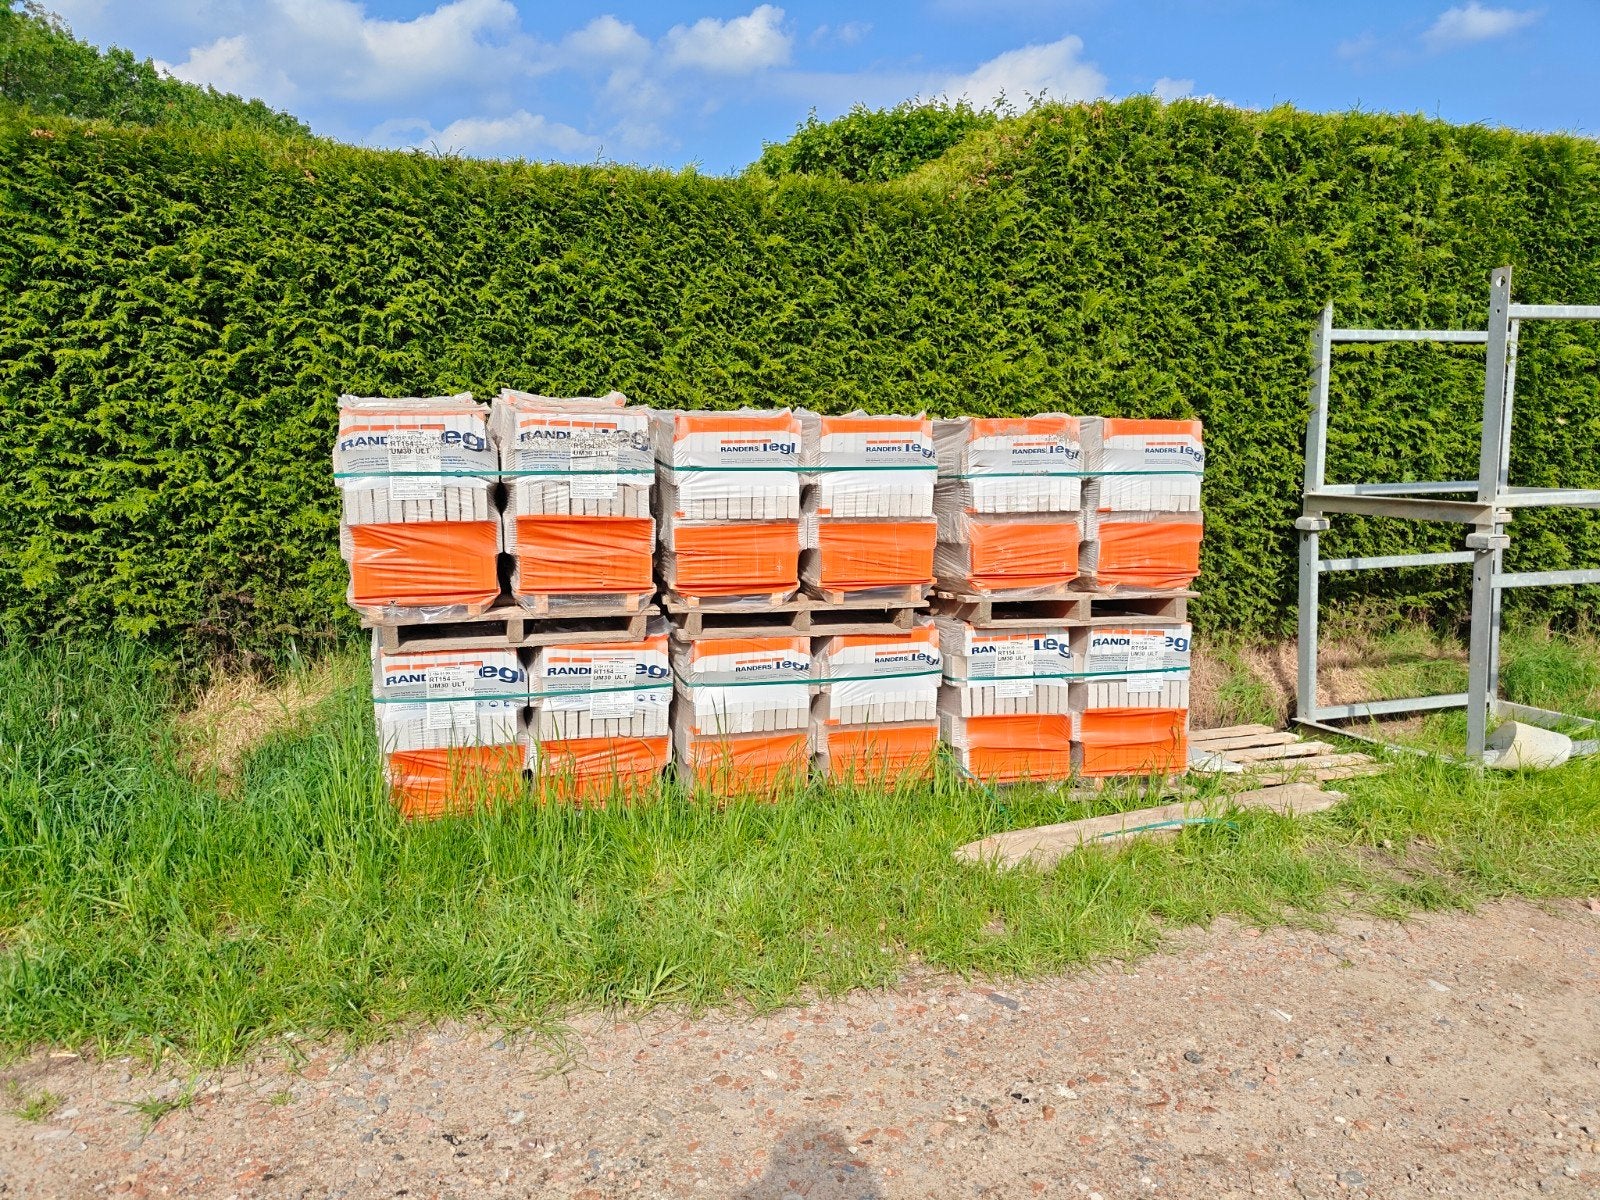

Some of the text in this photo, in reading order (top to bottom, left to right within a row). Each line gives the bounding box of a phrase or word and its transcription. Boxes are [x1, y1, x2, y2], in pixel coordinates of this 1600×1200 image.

[519, 430, 571, 442] RAND
[340, 436, 388, 451] RAND
[1012, 447, 1047, 455] RANDERS
[1092, 638, 1130, 647] RAND
[874, 655, 909, 663] RANDERS
[547, 667, 592, 676] RAND
[735, 664, 772, 672] RANDERS
[386, 673, 427, 685] RAND
[429, 675, 451, 683] RT154
